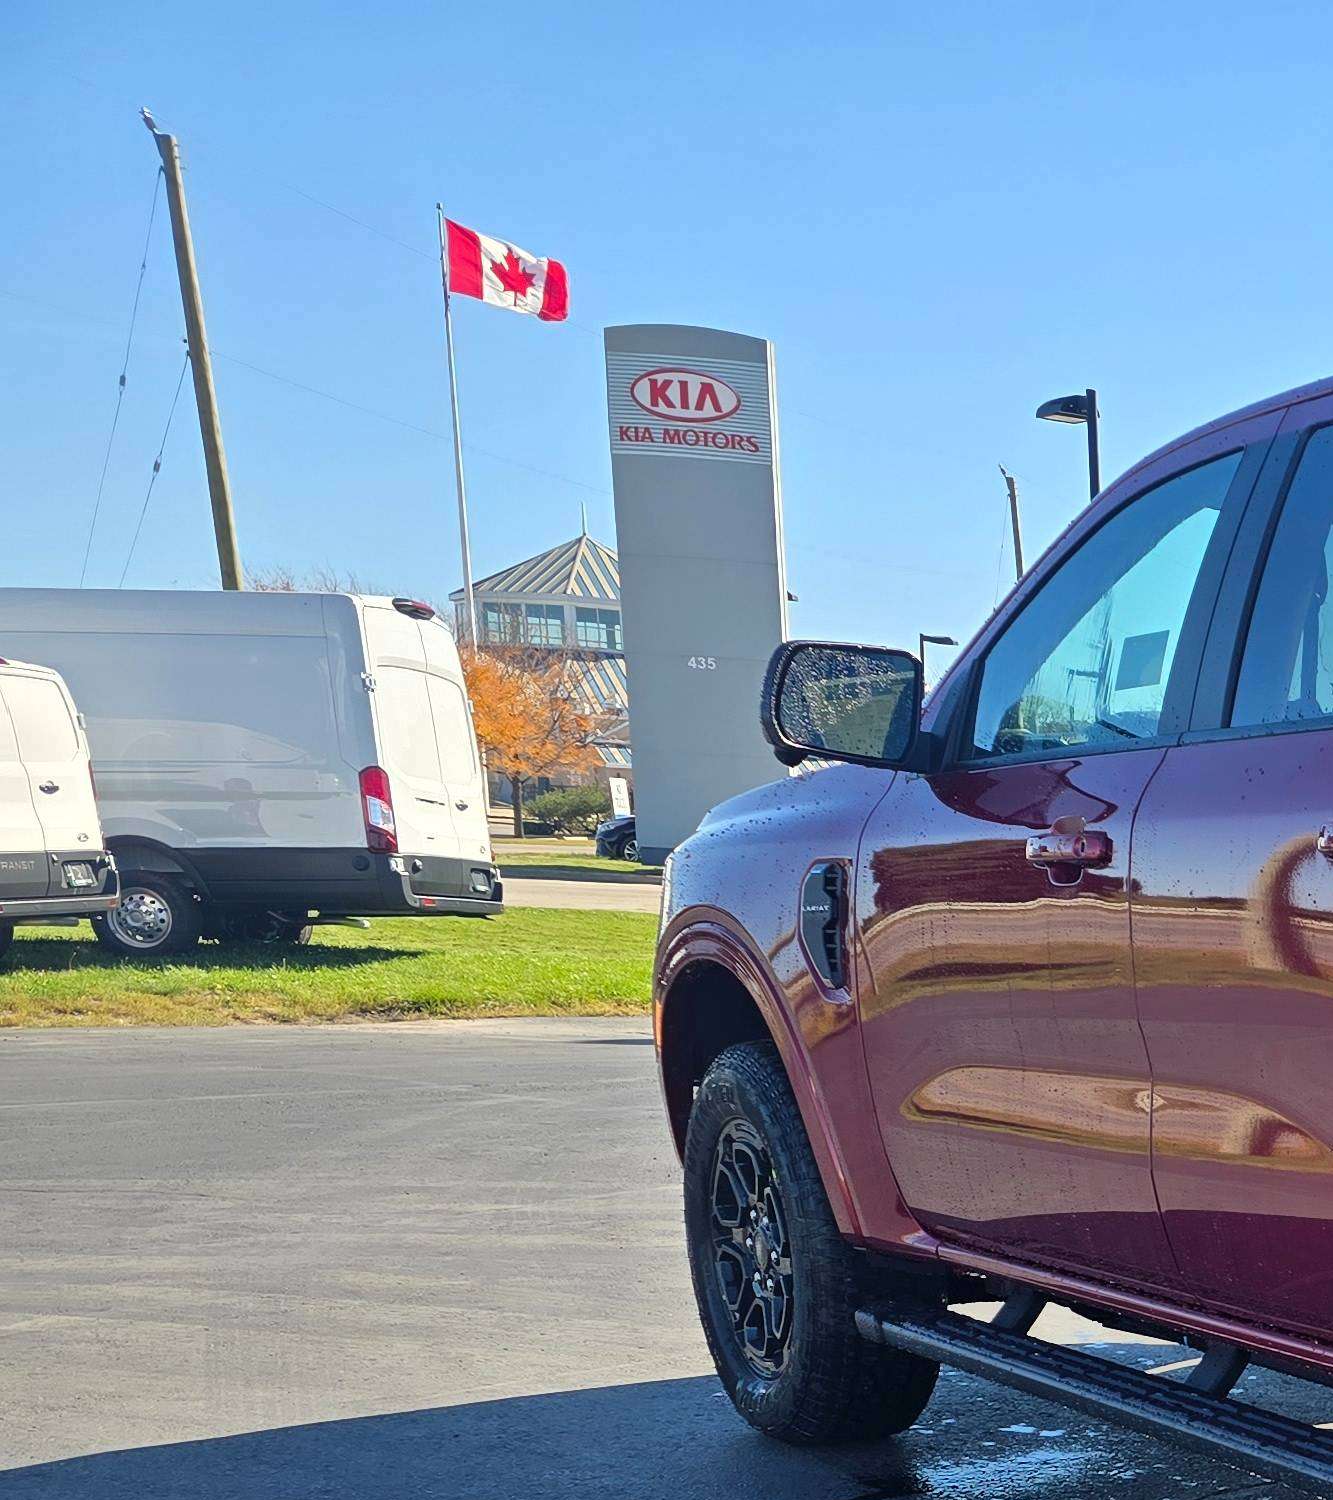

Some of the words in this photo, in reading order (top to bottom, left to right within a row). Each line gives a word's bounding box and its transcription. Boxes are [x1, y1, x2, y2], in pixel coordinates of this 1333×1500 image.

[648, 378, 724, 413] KIA
[619, 425, 655, 443] KIA
[662, 428, 760, 453] MOTORS
[687, 656, 717, 671] 435
